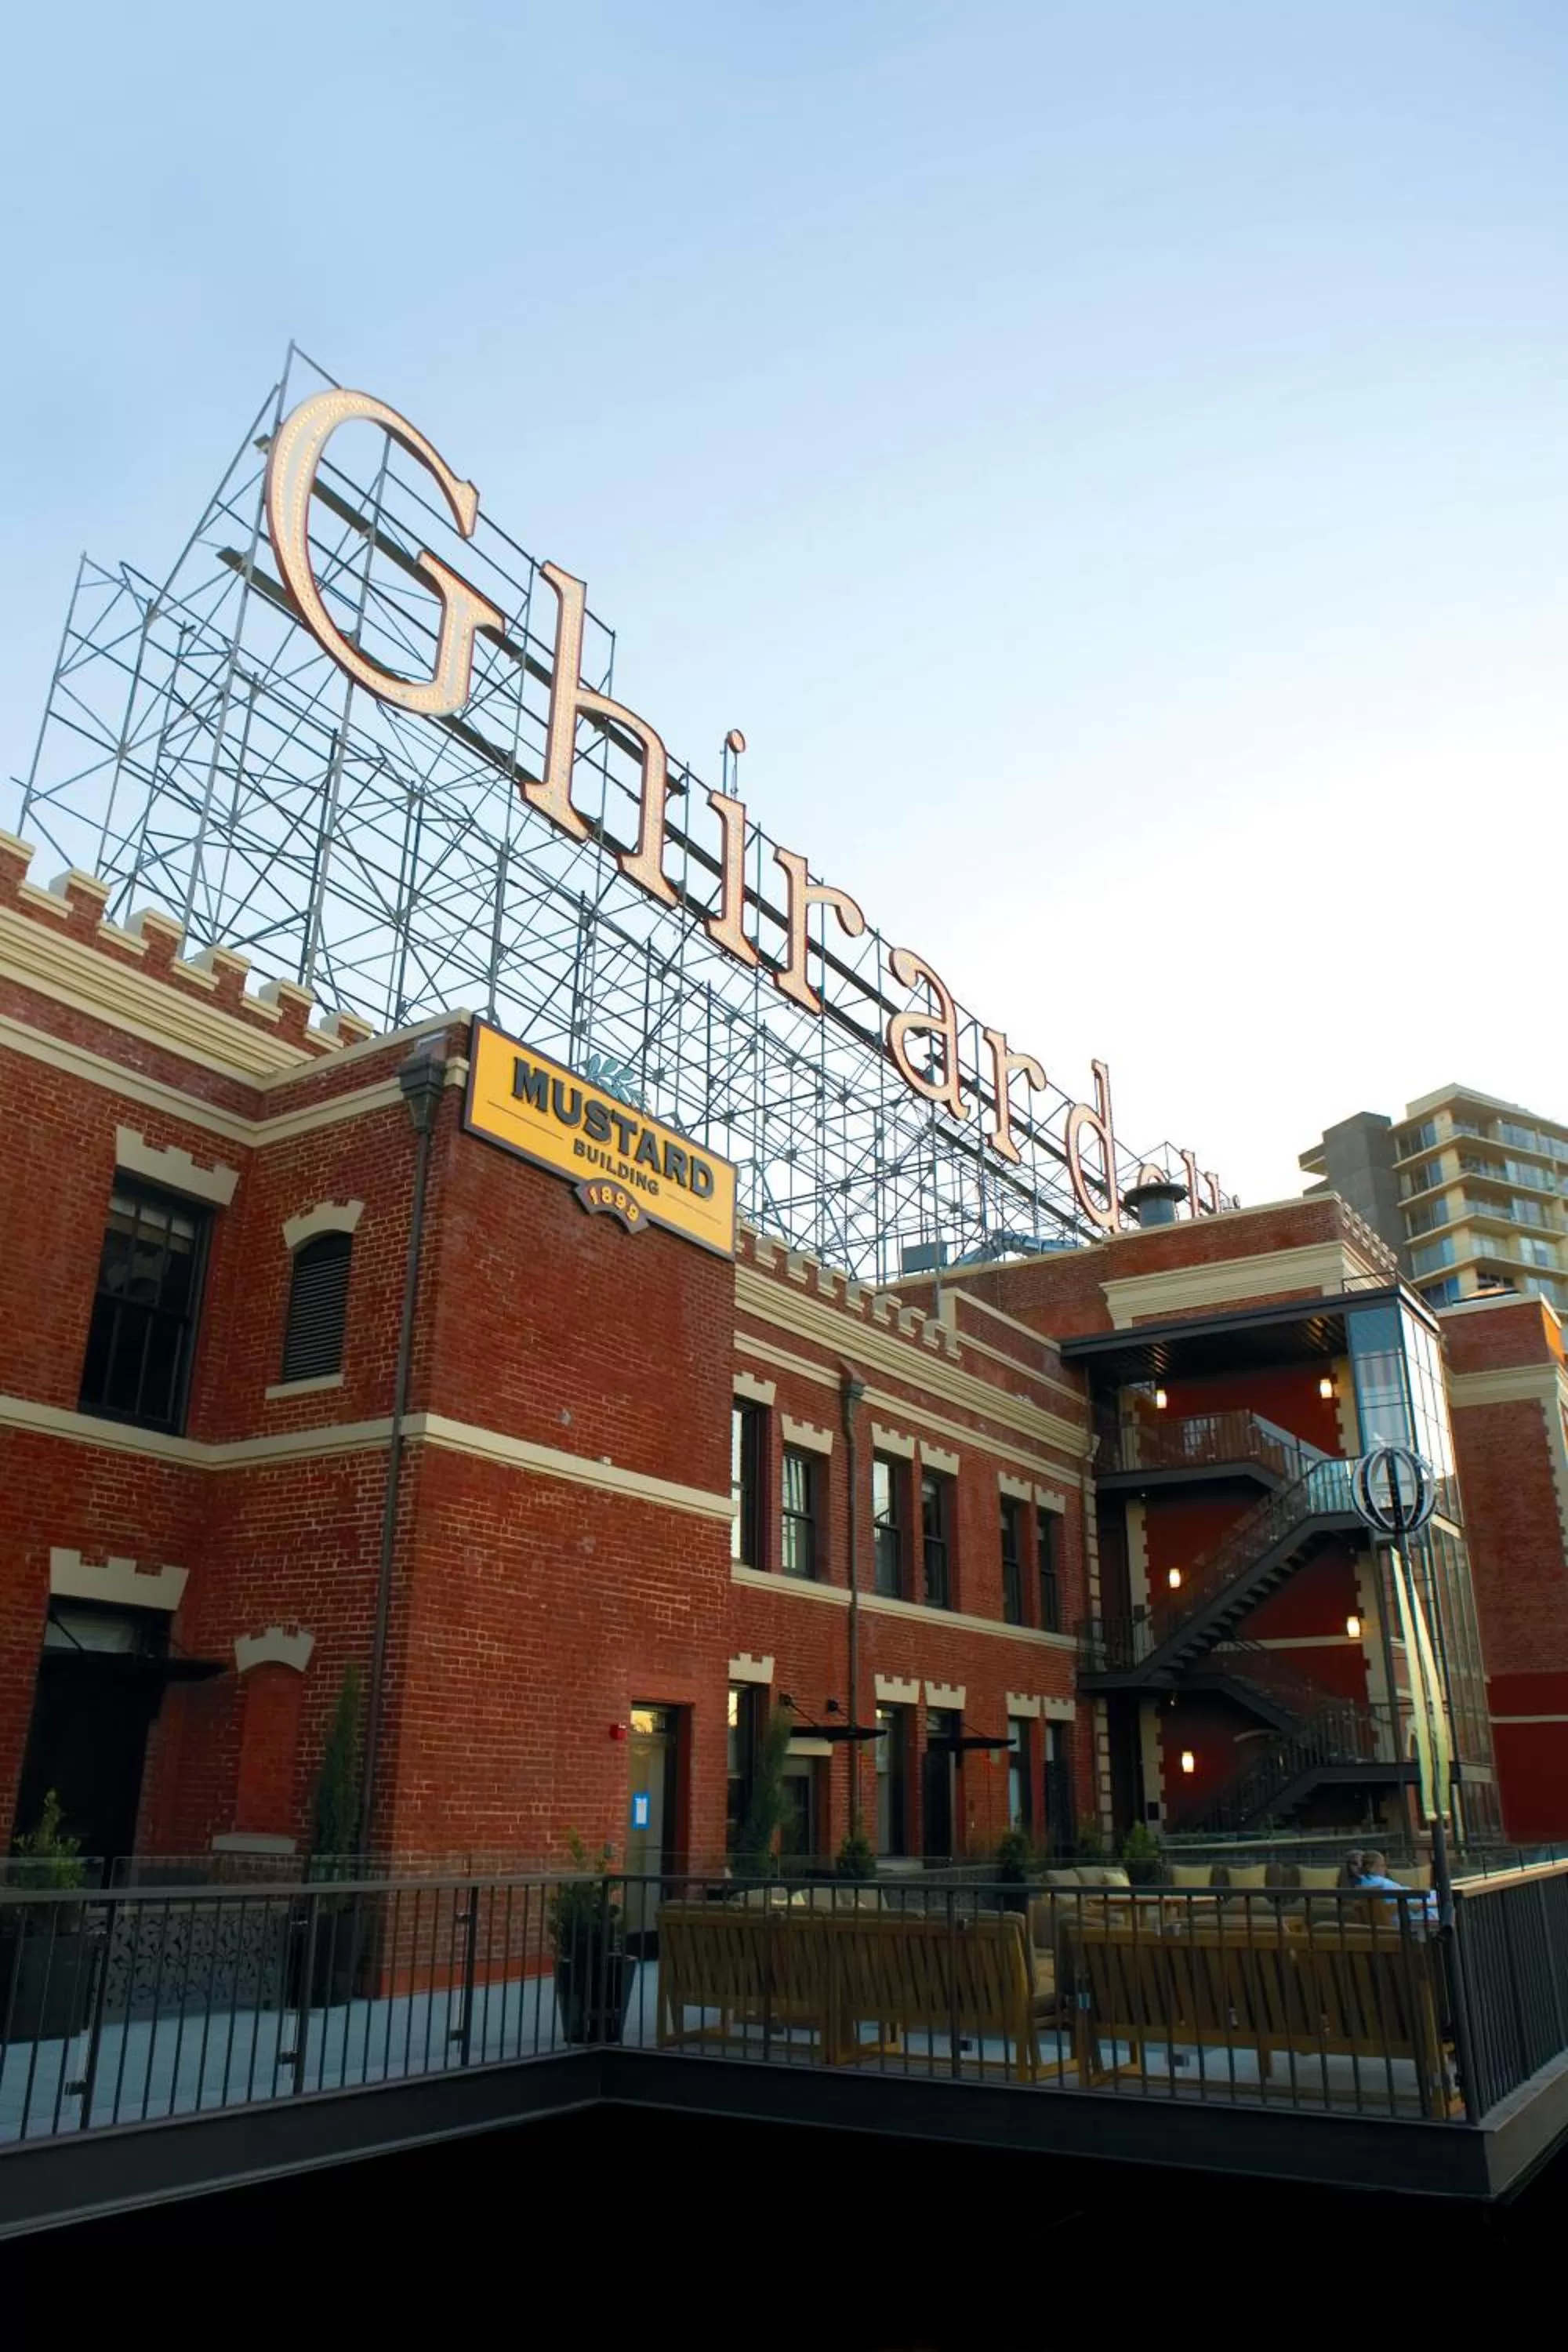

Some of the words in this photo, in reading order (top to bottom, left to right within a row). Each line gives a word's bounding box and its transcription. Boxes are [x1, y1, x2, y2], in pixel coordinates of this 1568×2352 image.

[265, 389, 1240, 1232] Ghirardll
[510, 1056, 714, 1200] MUSTARD
[573, 1138, 659, 1196] BUILDING
[588, 1185, 640, 1222] 1899
